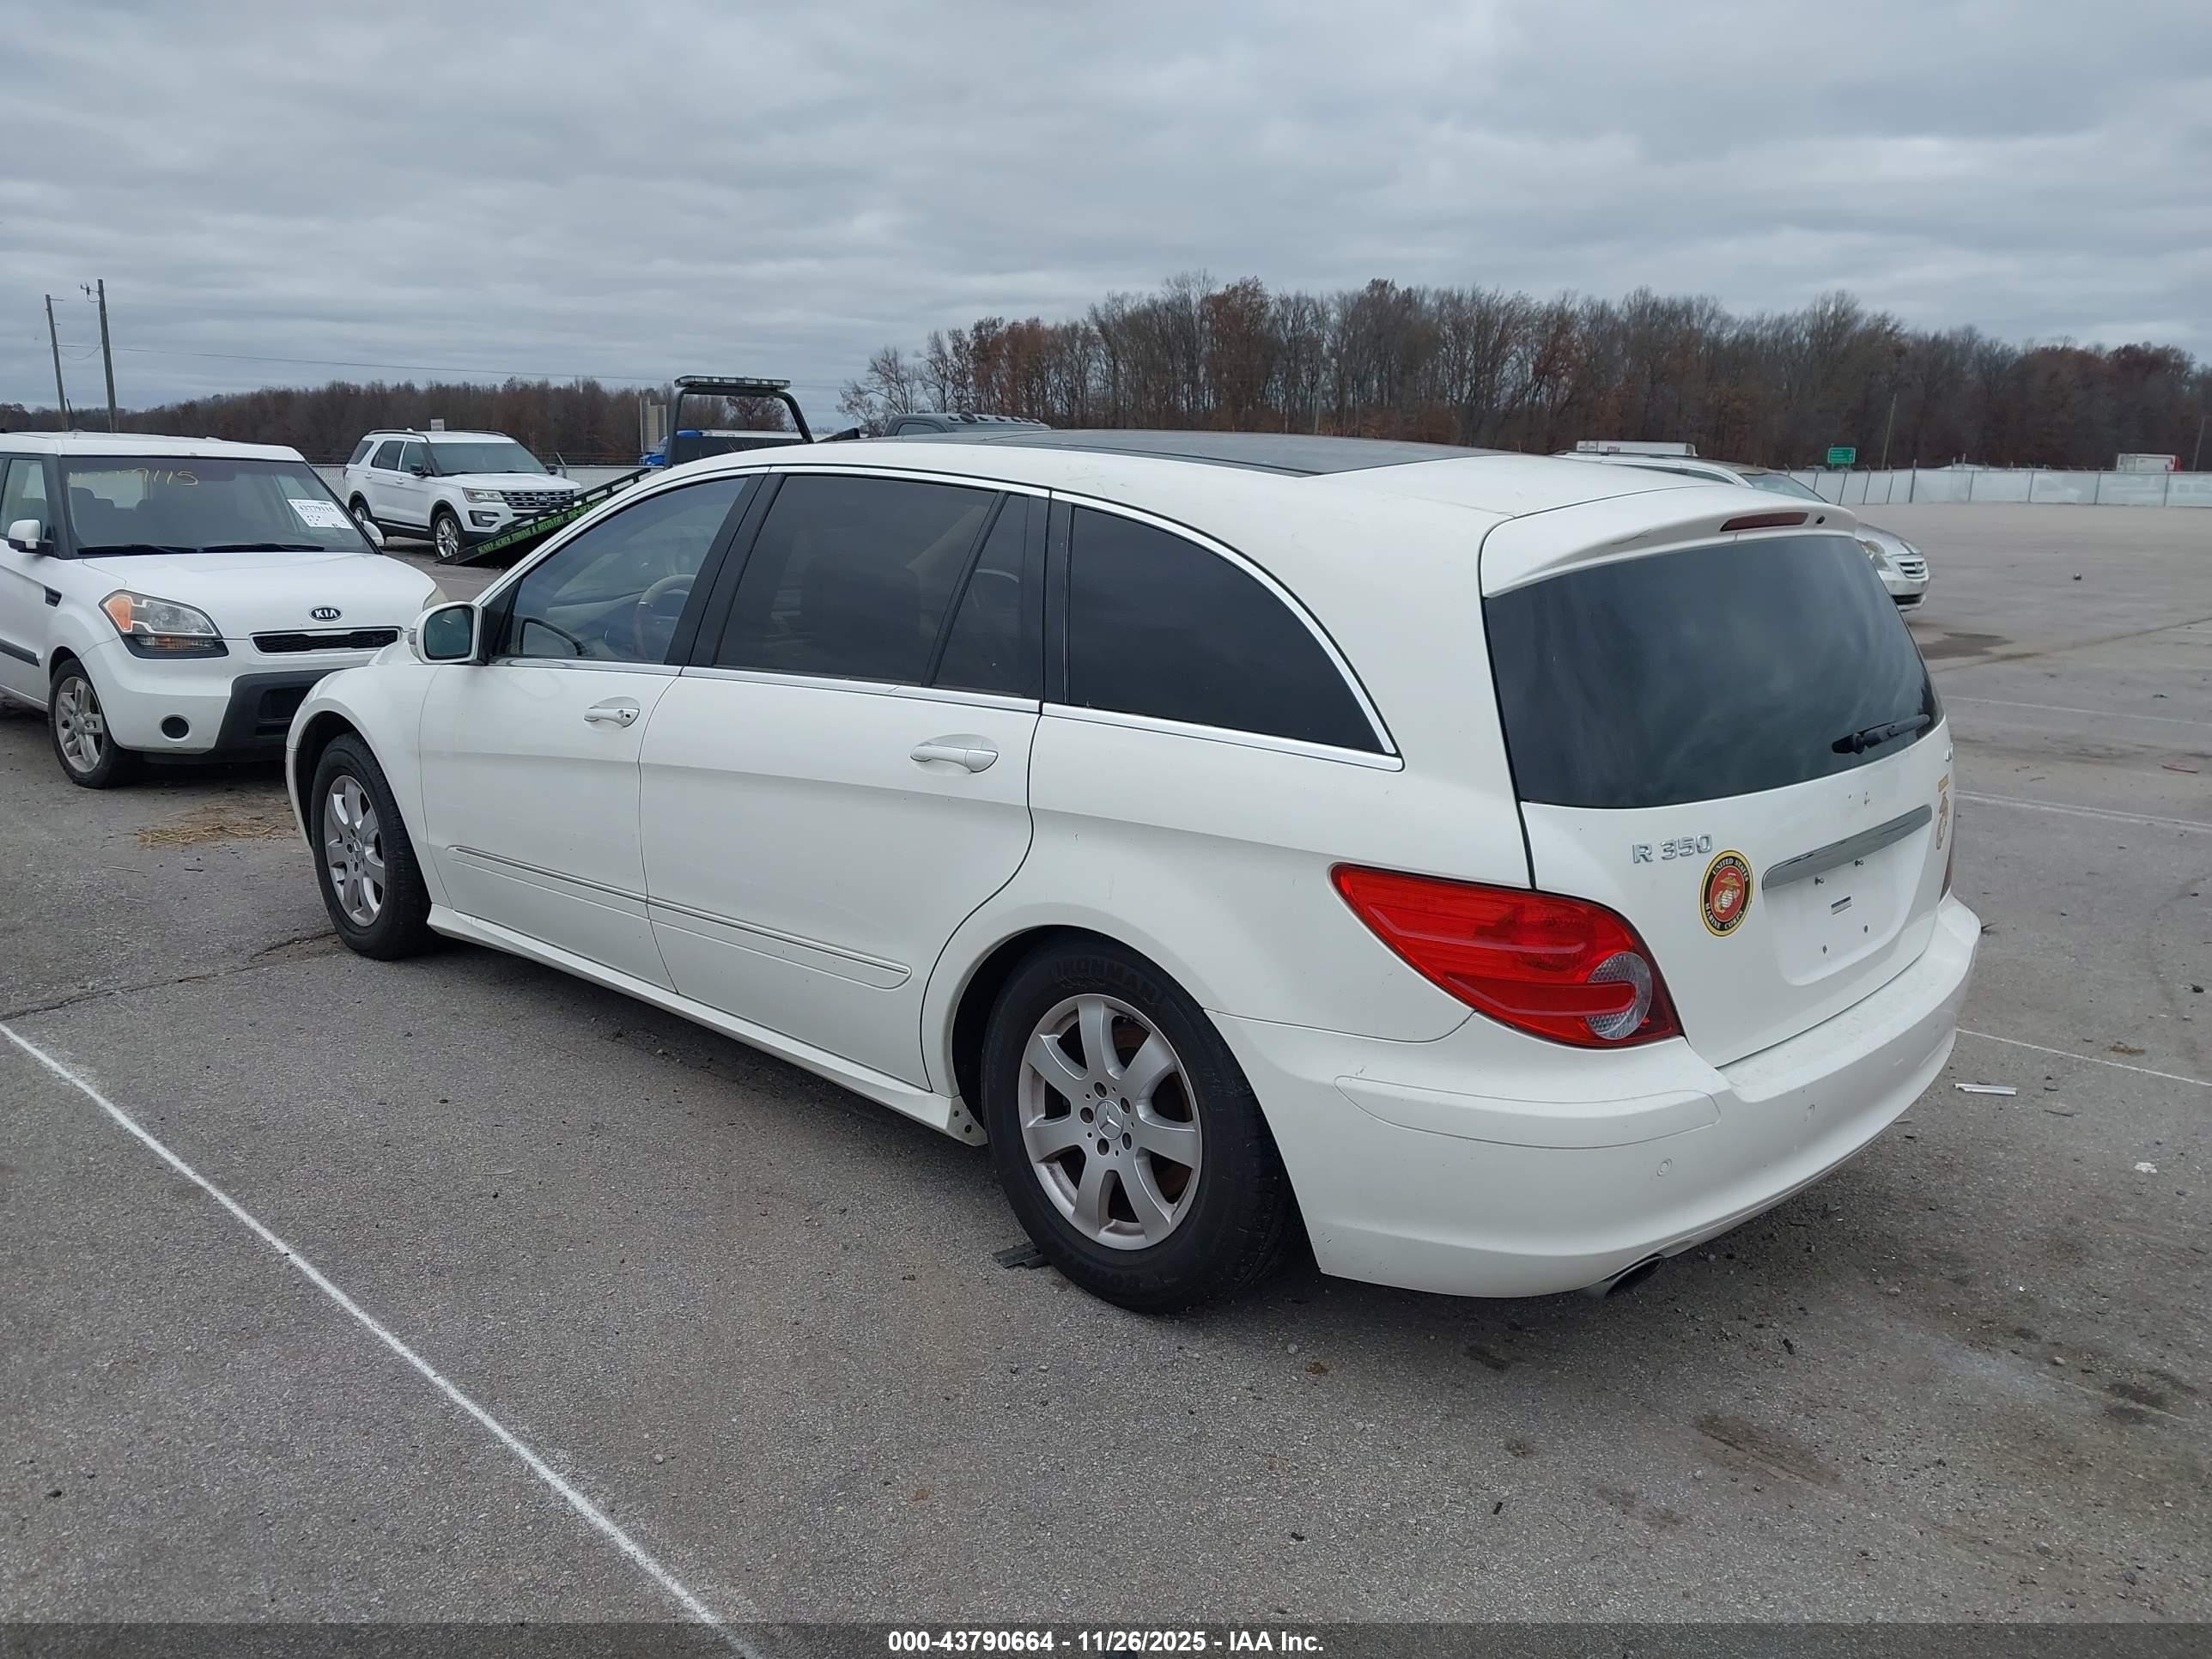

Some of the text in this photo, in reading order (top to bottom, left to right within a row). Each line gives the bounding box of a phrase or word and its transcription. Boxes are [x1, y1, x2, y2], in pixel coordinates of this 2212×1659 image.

[538, 515, 564, 532] RECOVERY
[314, 609, 337, 618] KIA
[1632, 834, 1712, 864] R 350
[1712, 857, 1749, 882] UNITED STATES
[1704, 902, 1743, 929] MARINE CORPS
